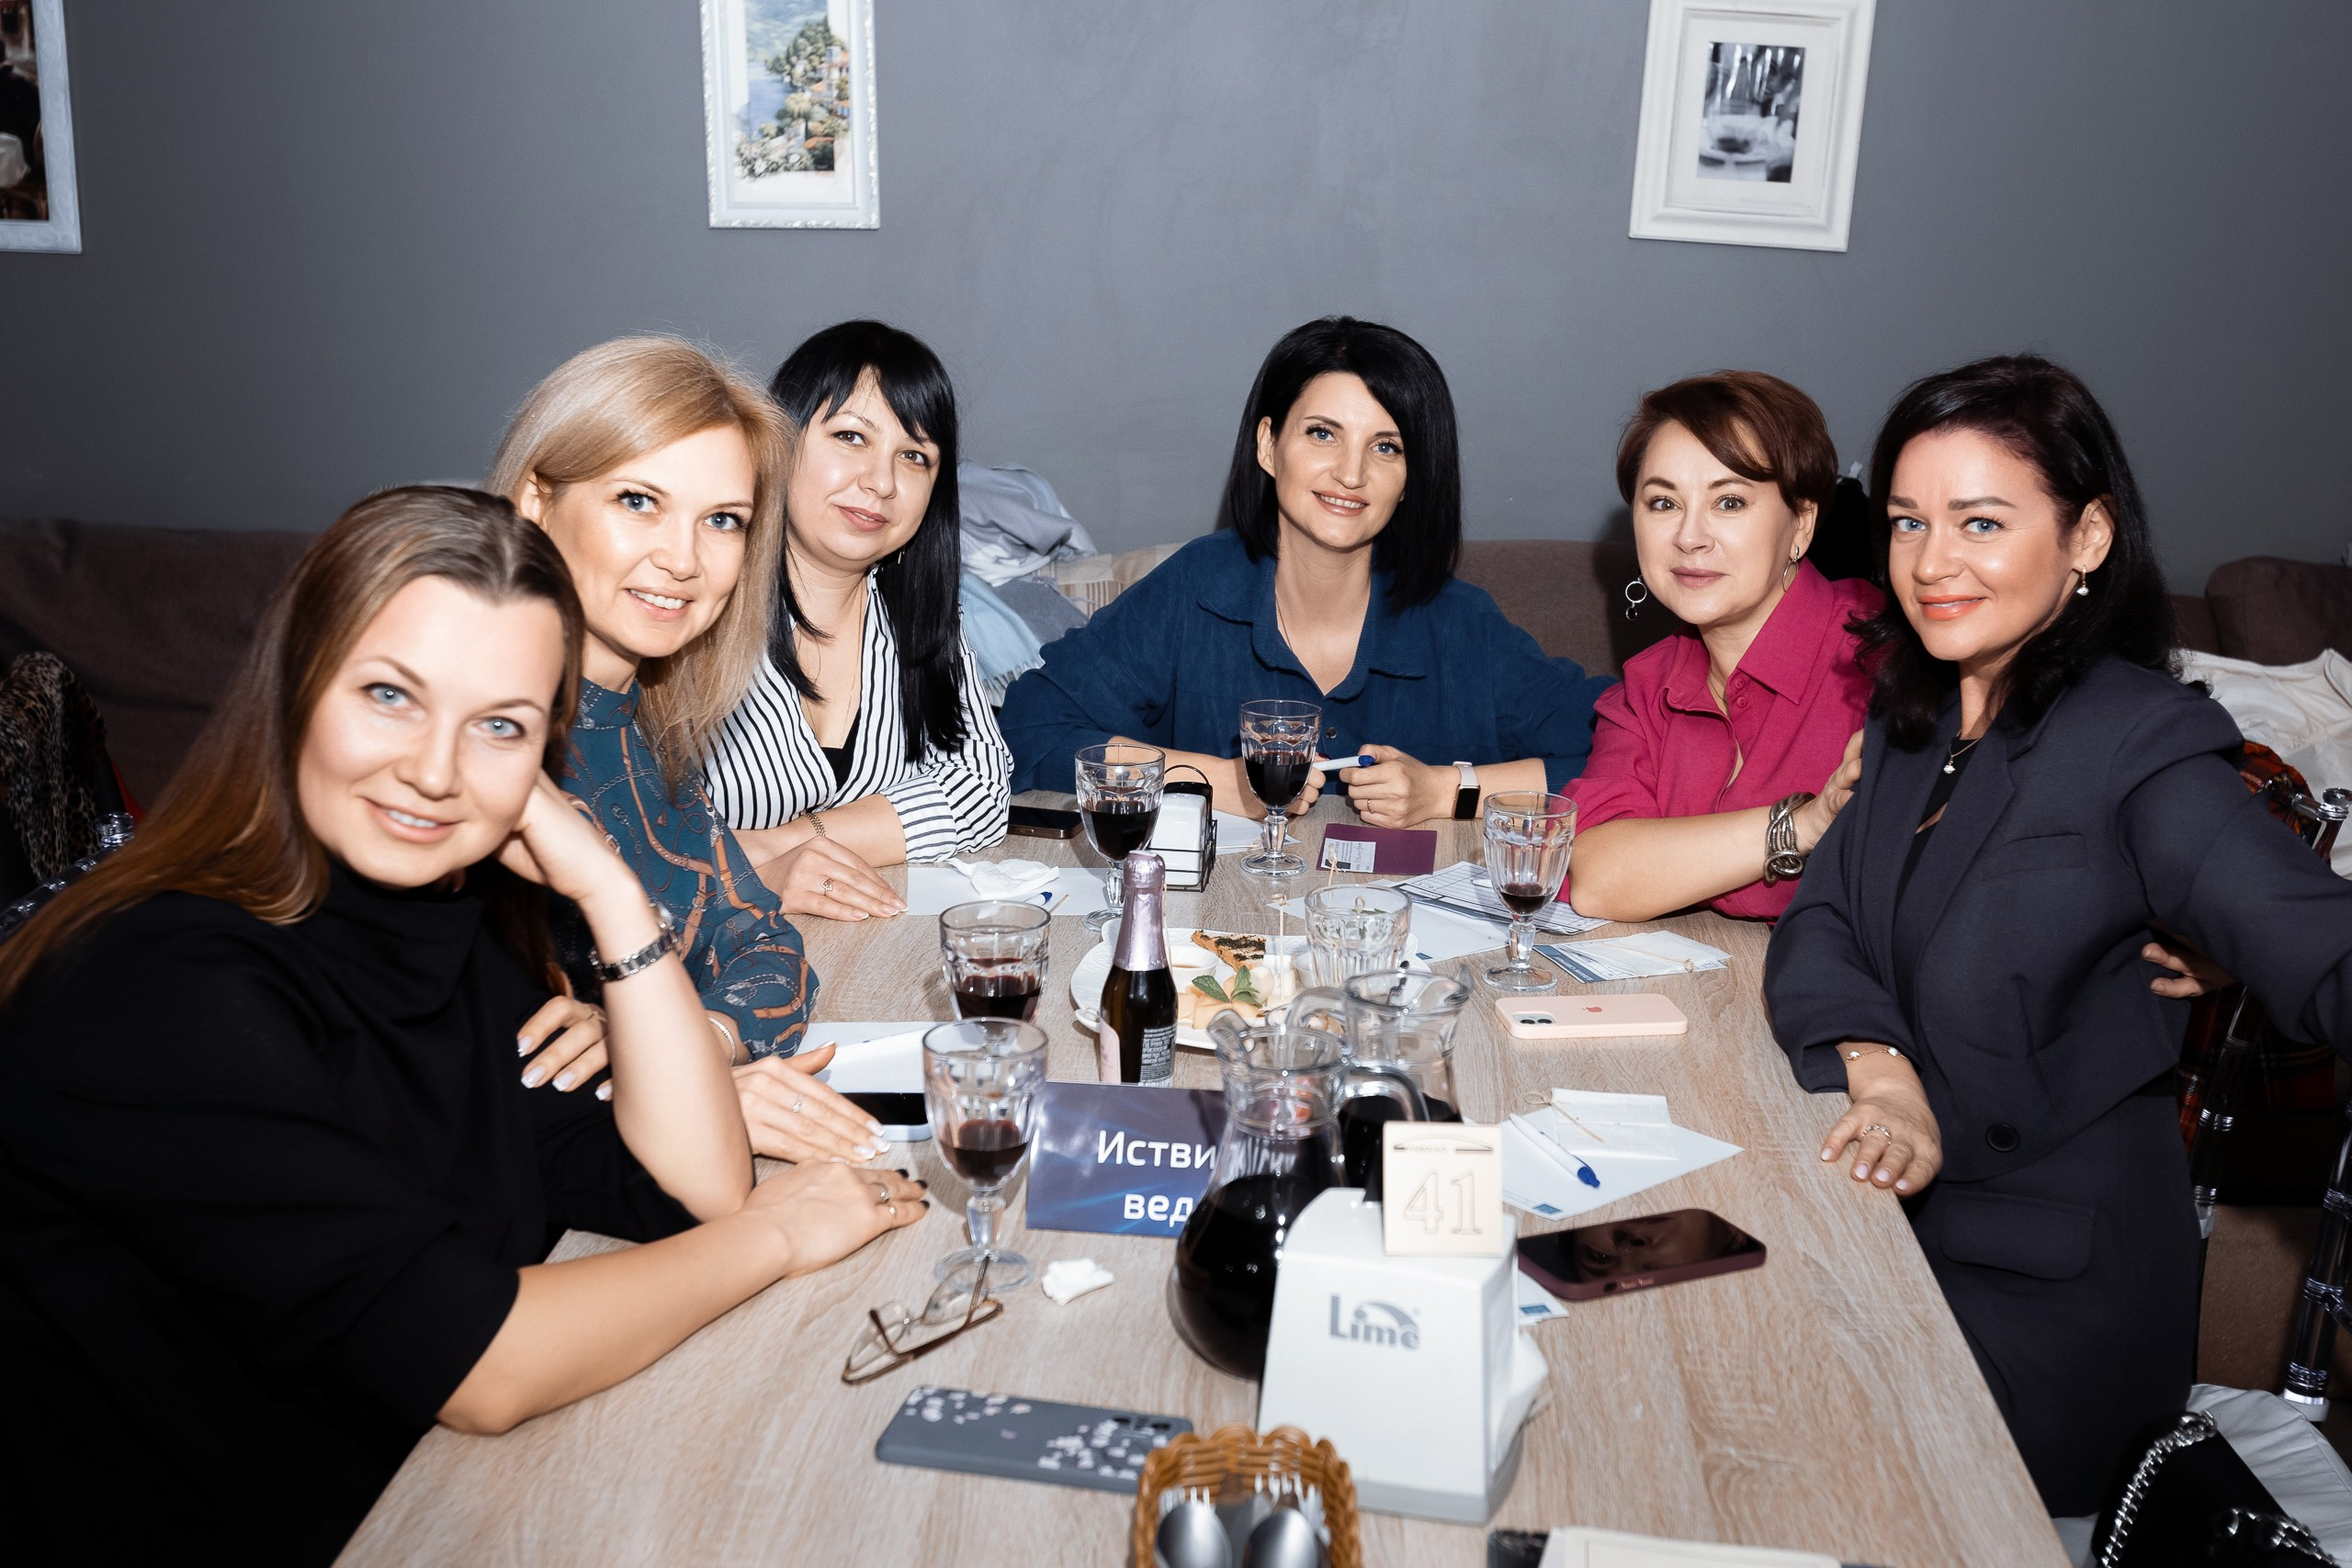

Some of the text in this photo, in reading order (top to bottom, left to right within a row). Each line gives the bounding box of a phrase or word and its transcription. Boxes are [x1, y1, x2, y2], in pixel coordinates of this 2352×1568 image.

[1098, 1130, 1216, 1170] Истви
[1124, 1193, 1193, 1228] вед
[1403, 1169, 1483, 1235] 41
[1329, 1294, 1419, 1349] Lime
